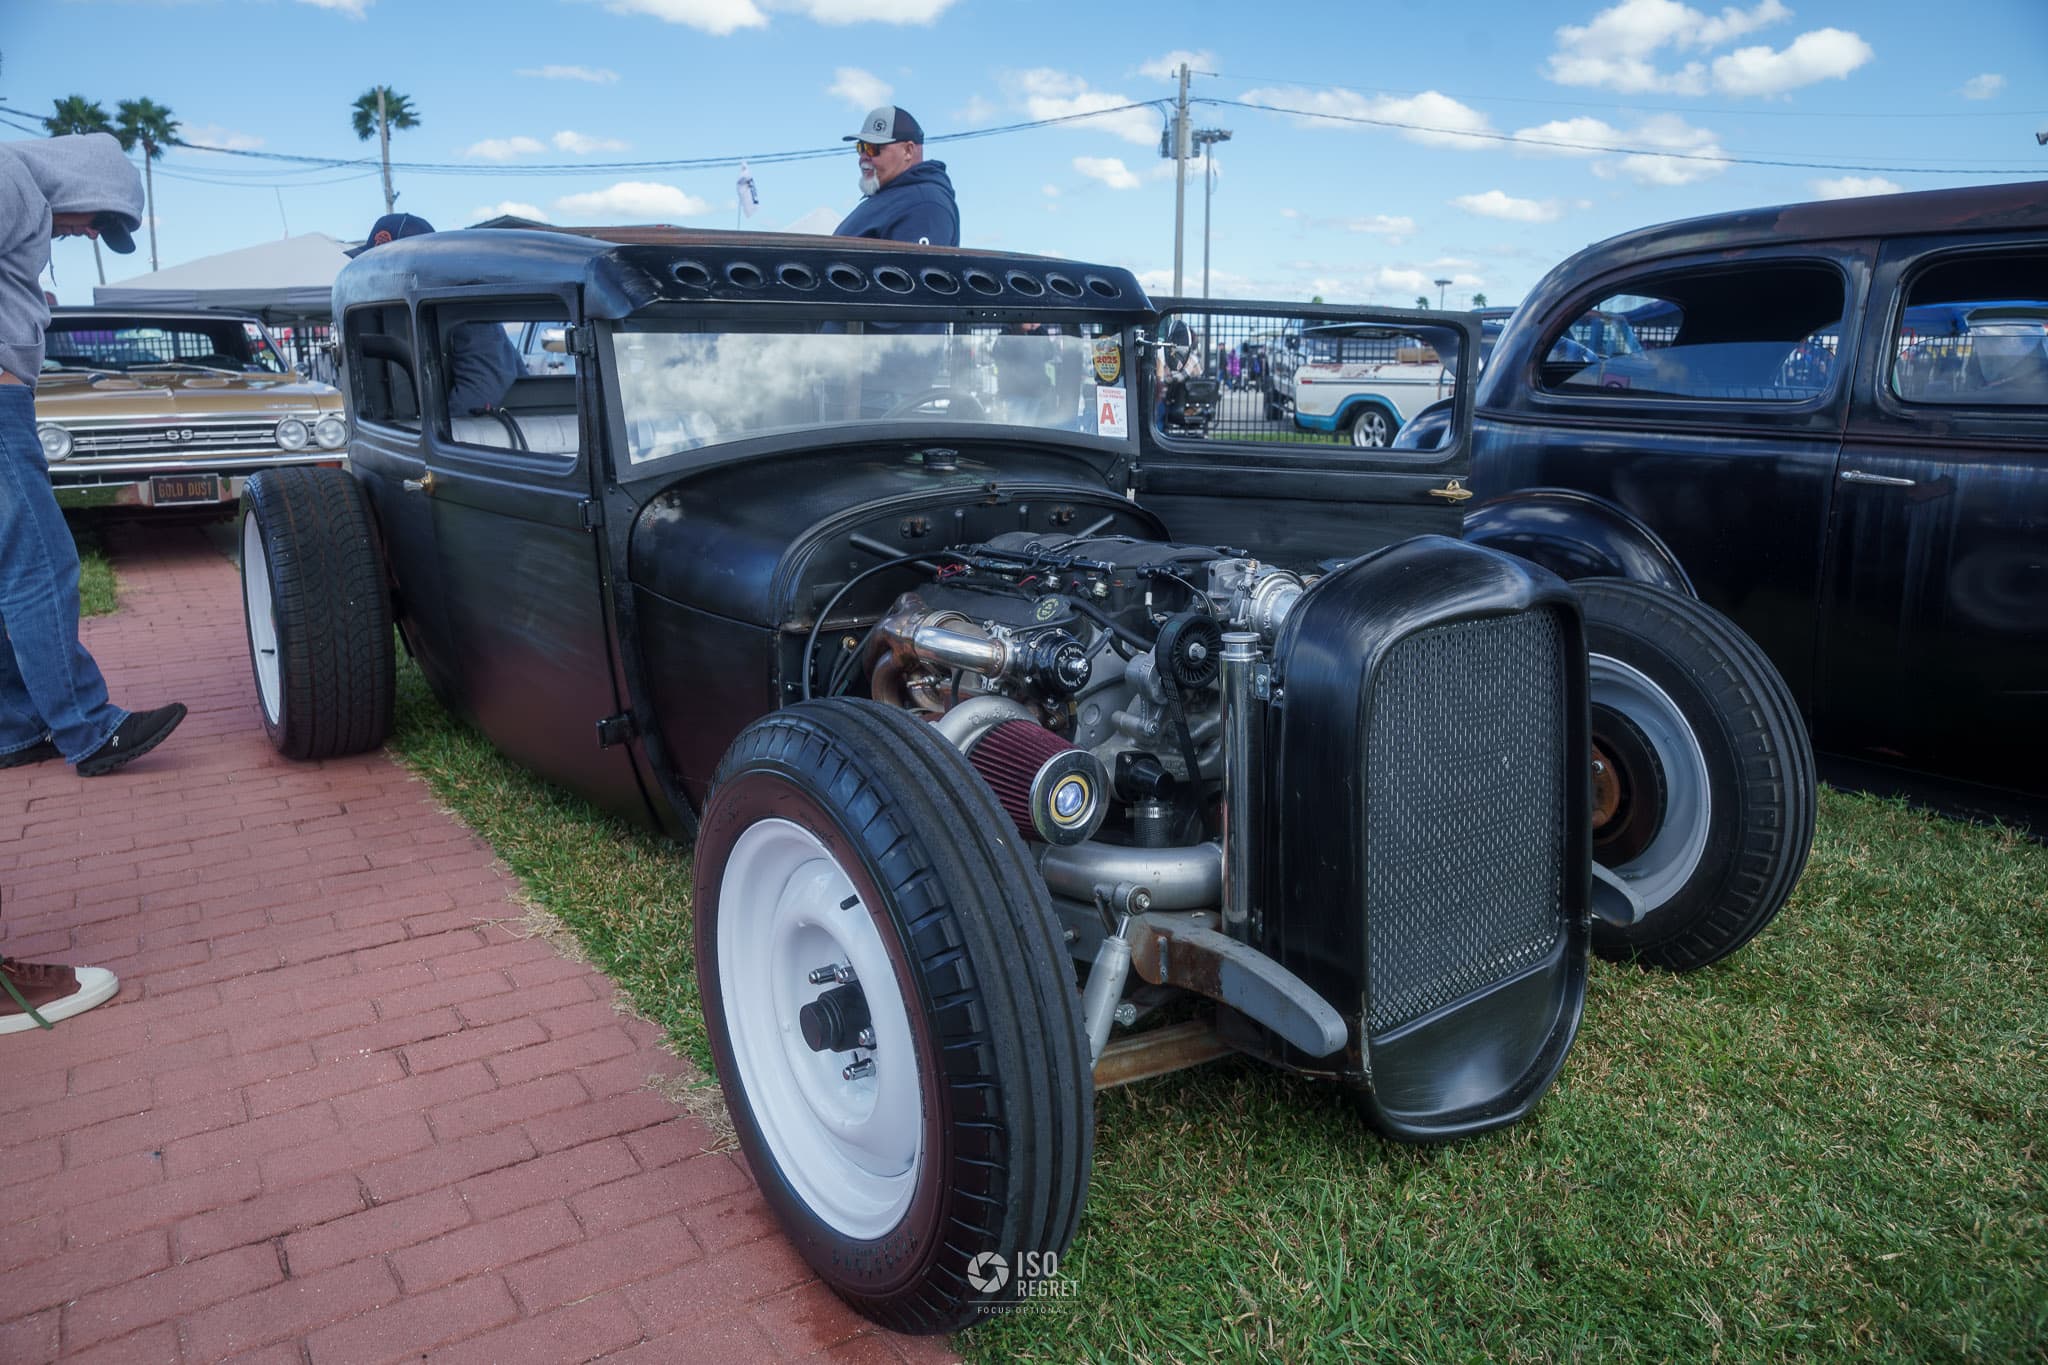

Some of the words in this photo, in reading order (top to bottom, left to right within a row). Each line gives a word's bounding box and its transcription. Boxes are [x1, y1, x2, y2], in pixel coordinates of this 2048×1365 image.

[1096, 355, 1118, 364] 2025
[1100, 402, 1116, 425] A
[166, 429, 193, 440] SS
[159, 482, 184, 497] GOLD
[188, 481, 212, 497] DUST
